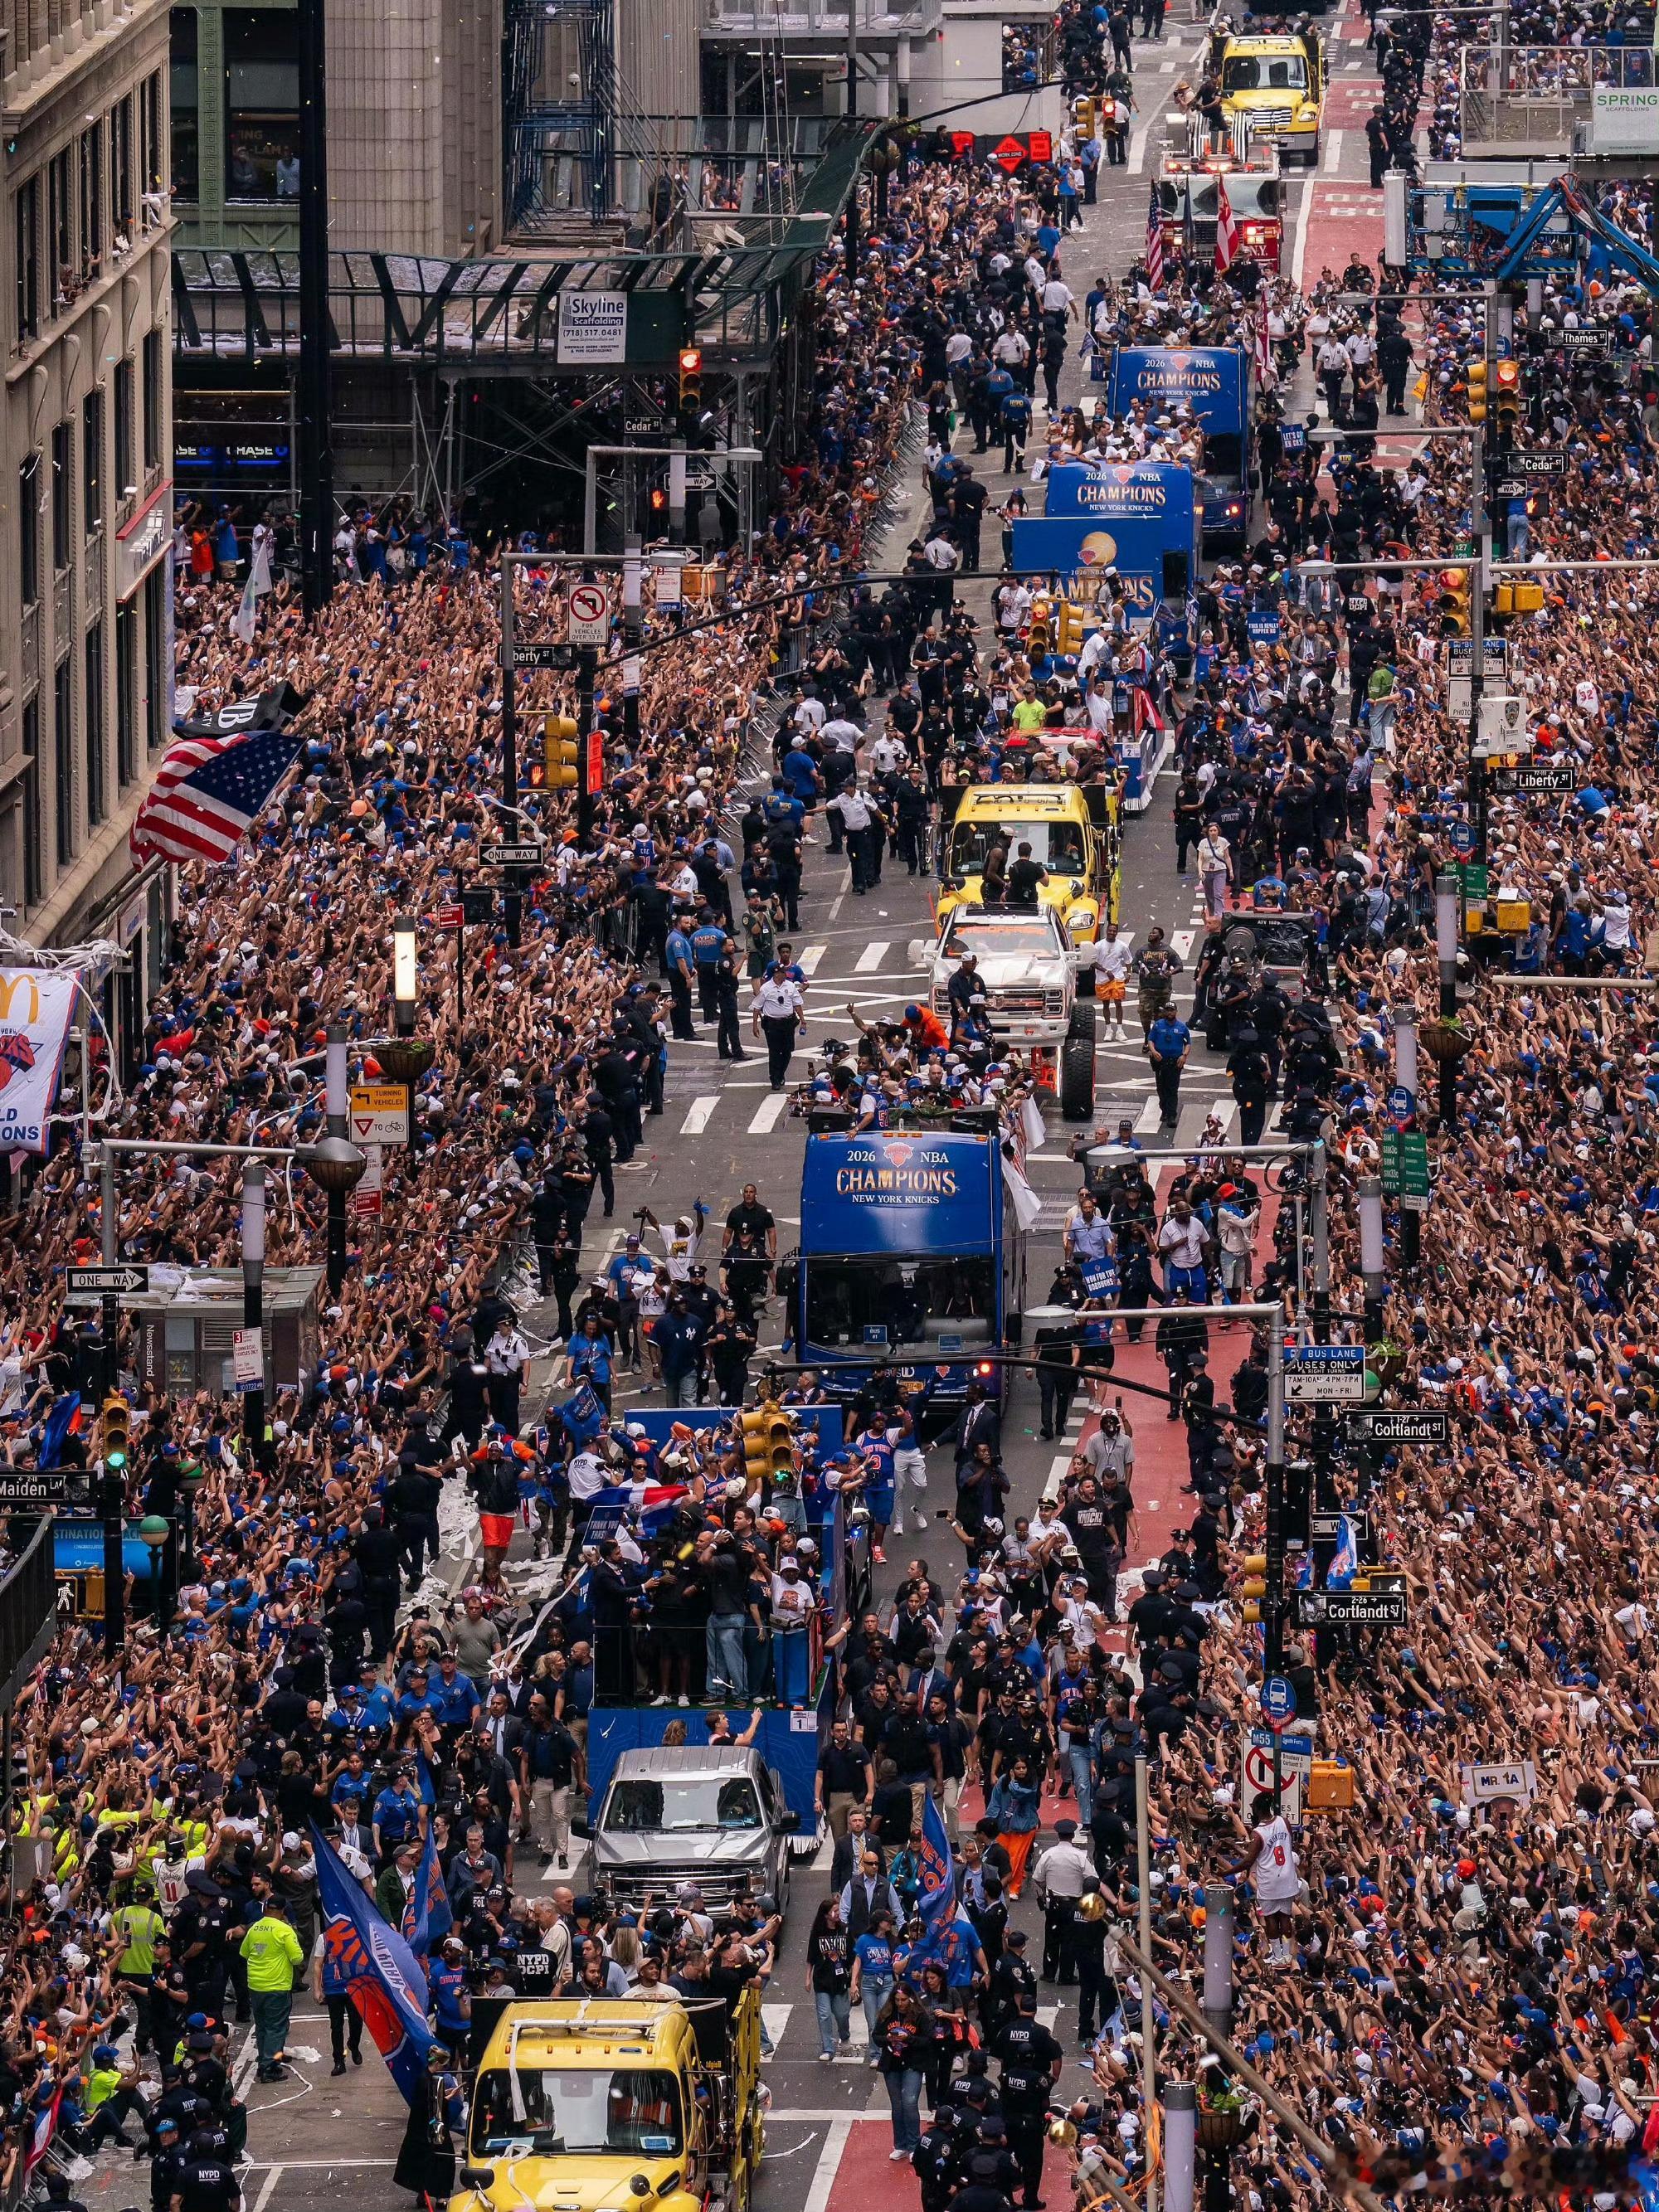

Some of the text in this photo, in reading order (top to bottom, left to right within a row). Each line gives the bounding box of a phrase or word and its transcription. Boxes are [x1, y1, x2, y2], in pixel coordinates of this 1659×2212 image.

[1598, 95, 1657, 105] SPRING
[572, 299, 624, 317] Skyline
[574, 318, 621, 326] Scaffolding
[1564, 333, 1598, 344] Thames
[1145, 359, 1216, 368] 2026 NBA
[625, 421, 652, 431] Cedar
[1525, 459, 1554, 470] Cedar
[1085, 472, 1161, 481] 2026 NBA
[1077, 485, 1166, 507] CHAMPIONS
[513, 647, 541, 664] berty
[1126, 748, 1131, 756] 2
[1519, 774, 1559, 789] Liberty
[488, 850, 507, 859] ONE
[375, 1089, 402, 1097] TURNING
[373, 1098, 404, 1106] VEHICLES
[846, 1150, 949, 1163] 2026 NBA
[836, 1168, 956, 1197] CHAMPIONS
[1384, 1181, 1396, 1189] MTA
[852, 1194, 940, 1204] NEW YORK KNICKS
[78, 1273, 136, 1286] ONE WAY
[236, 1332, 241, 1343] 3
[145, 1325, 155, 1378] Newsstand
[1308, 1349, 1356, 1359] BUS LANE
[1330, 1360, 1356, 1369] ONLY
[1374, 1422, 1442, 1437] Cortlandt ST
[0, 1480, 46, 1496] Maiden
[1078, 1511, 1102, 1524] KNICKS
[590, 1519, 620, 1530] THANK YOU
[54, 1529, 105, 1540] STINATIO
[1328, 1603, 1400, 1619] Cortlandt ST
[1263, 1709, 1292, 1726] NO STANDING
[796, 1719, 803, 1729] 1
[1253, 1733, 1271, 1745] M55
[1282, 1736, 1304, 1747] South Ferry
[1282, 1753, 1299, 1762] Broadway
[1481, 1776, 1501, 1787] MR.
[1267, 1830, 1288, 1849] ANUNOBY
[1273, 1845, 1286, 1867] 8
[165, 1882, 178, 1903] 11
[518, 1954, 550, 1965] NYPD
[1010, 2030, 1029, 2040] NYPD
[955, 2080, 971, 2091] NYPD
[1008, 2076, 1026, 2087] NYPD
[212, 2132, 226, 2142] YPD
[199, 2170, 220, 2179] NYPD
